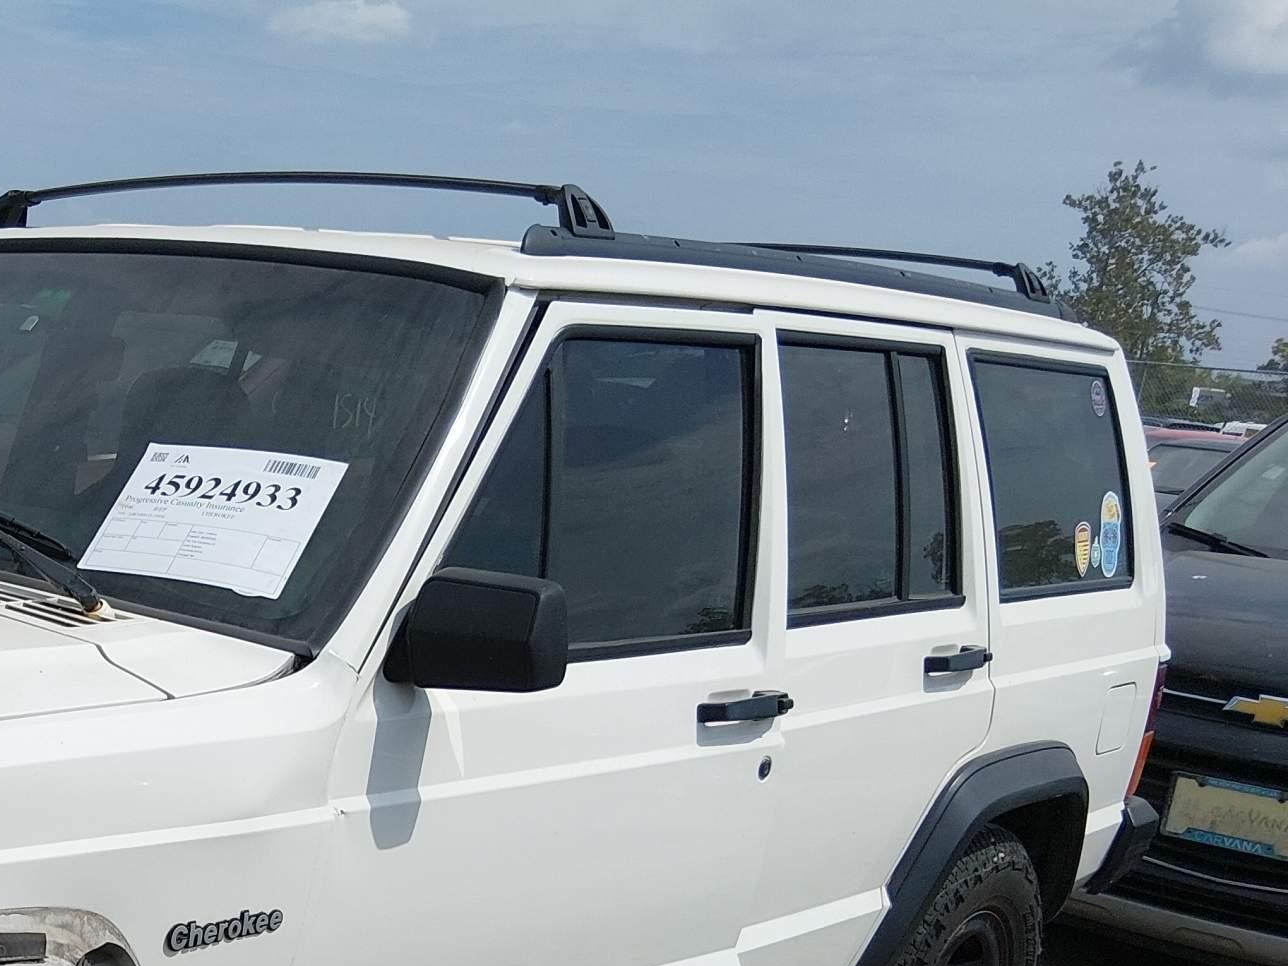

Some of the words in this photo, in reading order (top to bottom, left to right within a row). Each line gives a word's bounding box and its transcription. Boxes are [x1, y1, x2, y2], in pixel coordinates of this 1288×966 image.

[125, 494, 169, 505] Progressive
[170, 498, 203, 509] Casualty
[205, 501, 245, 513] Insurance
[144, 472, 303, 511] 45924933
[1193, 830, 1264, 854] CARVANA
[164, 908, 284, 956] Cherokee
